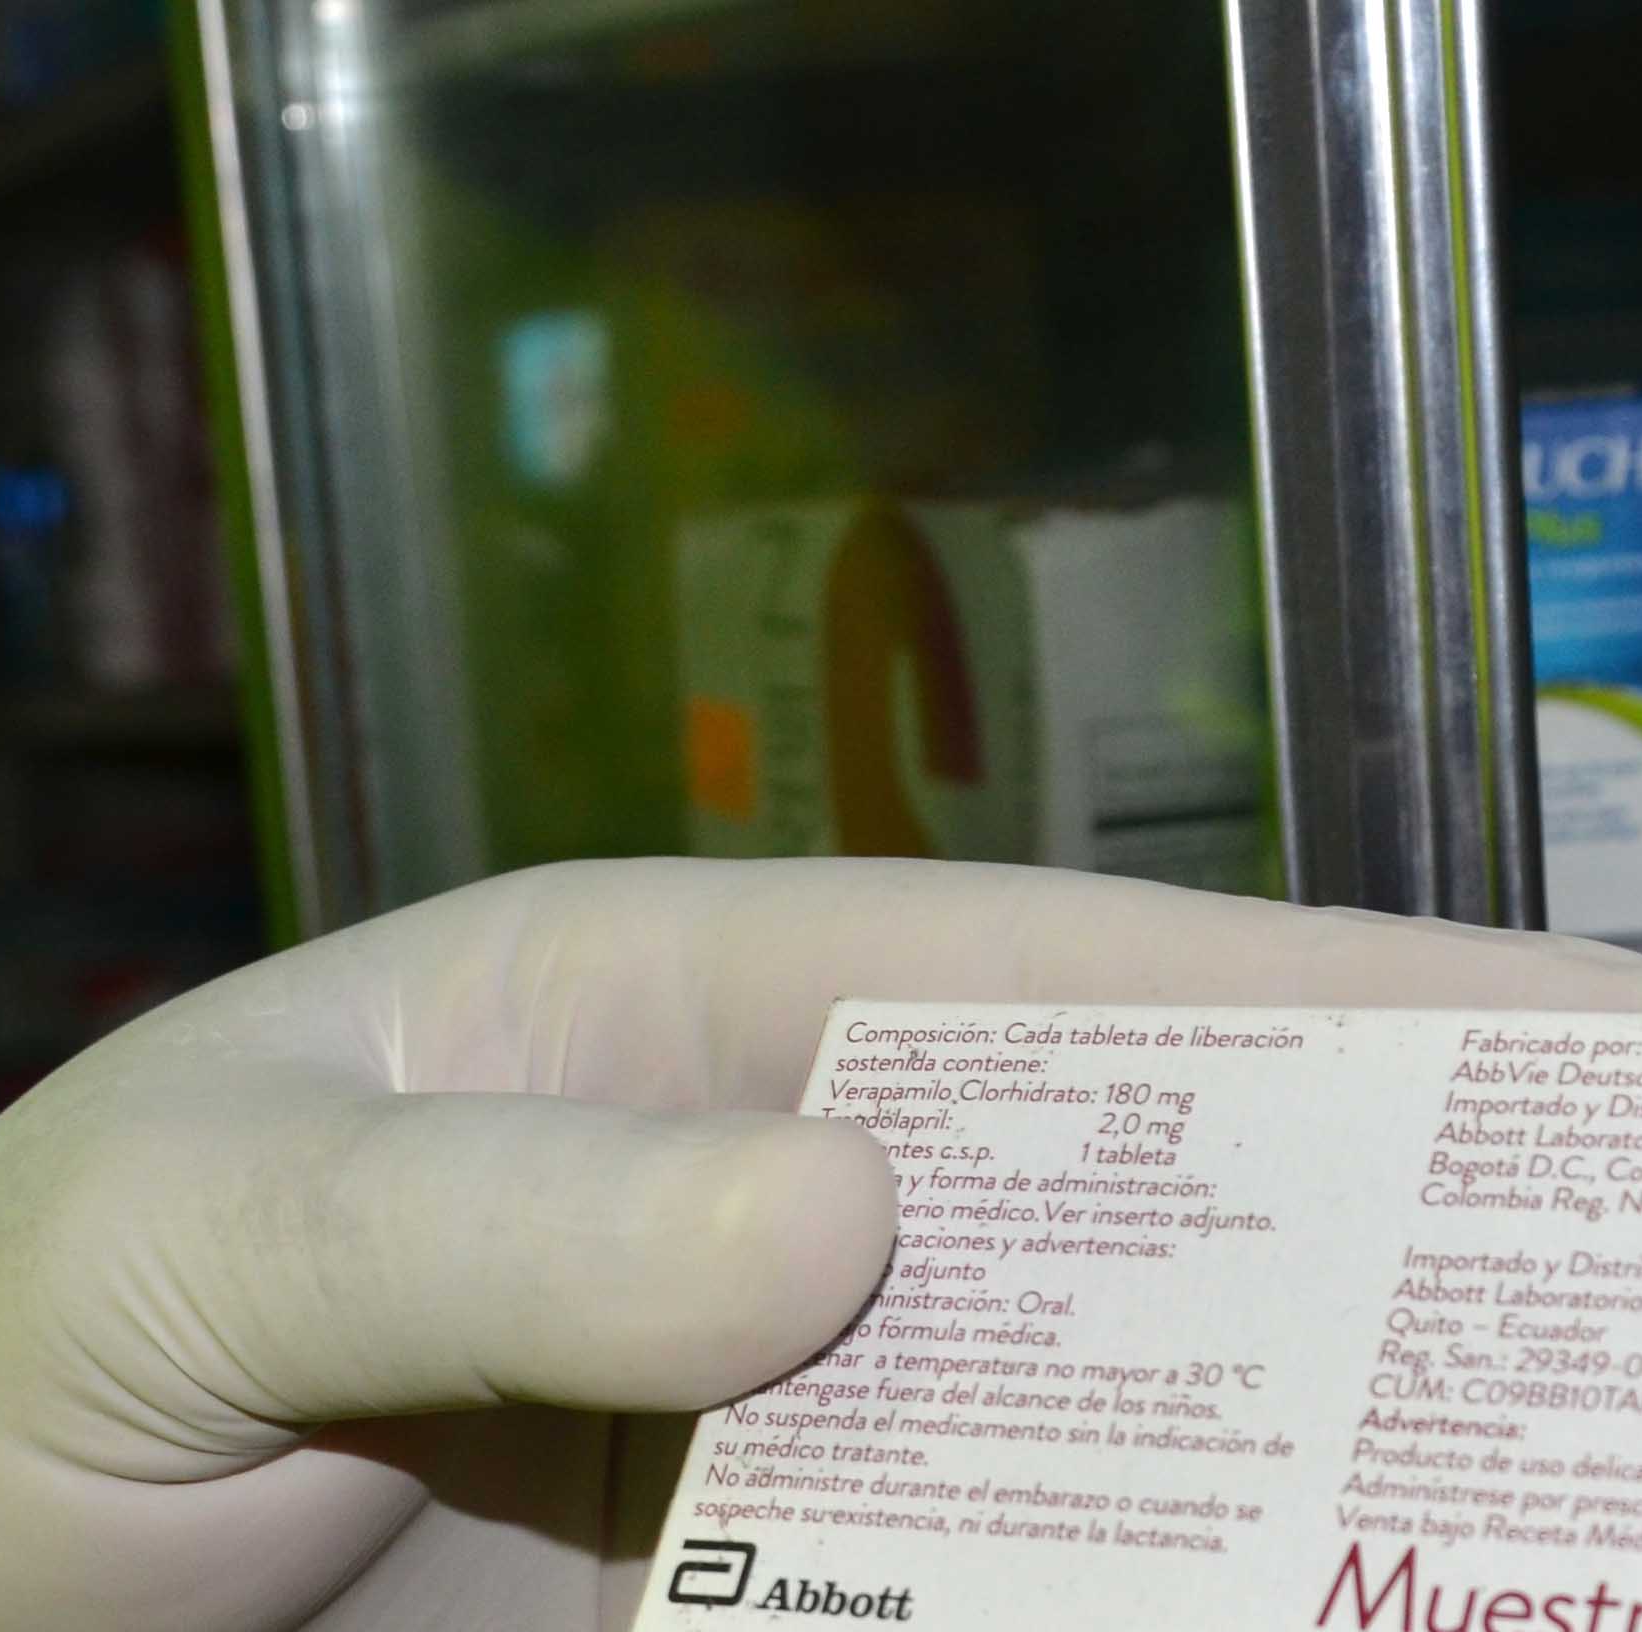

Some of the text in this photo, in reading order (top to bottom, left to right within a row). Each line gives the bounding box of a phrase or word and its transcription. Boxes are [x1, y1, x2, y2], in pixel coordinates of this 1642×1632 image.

[845, 1020, 1305, 1051] Composición: Cada tableta liberación
[835, 1049, 1049, 1075] sostenida contiene:
[829, 1078, 1196, 1114] Verapamilo Clorhidrato: 180 mg
[822, 1106, 954, 1137] Tndolapril:
[1096, 1111, 1186, 1144] 2,0 mg
[937, 1144, 995, 1168] c.s.p.
[1095, 1142, 1178, 1168] tableta
[928, 1167, 998, 1193] forma
[1035, 1172, 1218, 1199] administración:
[949, 1199, 1040, 1225] médico.
[1045, 1201, 1088, 1226] Ver
[1090, 1203, 1175, 1229] inserto
[1178, 1206, 1277, 1237] adjunto.
[1020, 1232, 1177, 1259] advertencias:
[899, 1256, 989, 1288] adjunto
[1016, 1290, 1076, 1316] Oral.
[877, 1317, 967, 1344] fórmula
[971, 1321, 1062, 1347] médica.
[893, 1349, 1040, 1382] temperatura
[1080, 1363, 1161, 1388] mayor
[1184, 1360, 1225, 1385] 30
[769, 1377, 1222, 1420] nténgase fuera del alcance los niños.
[724, 1403, 1259, 1456] No suspenda medicamento sin indicación
[741, 1436, 929, 1467] médico tratante.
[704, 1462, 1230, 1520] No administre durante embarazo cuando
[754, 1575, 916, 1624] Abbott
